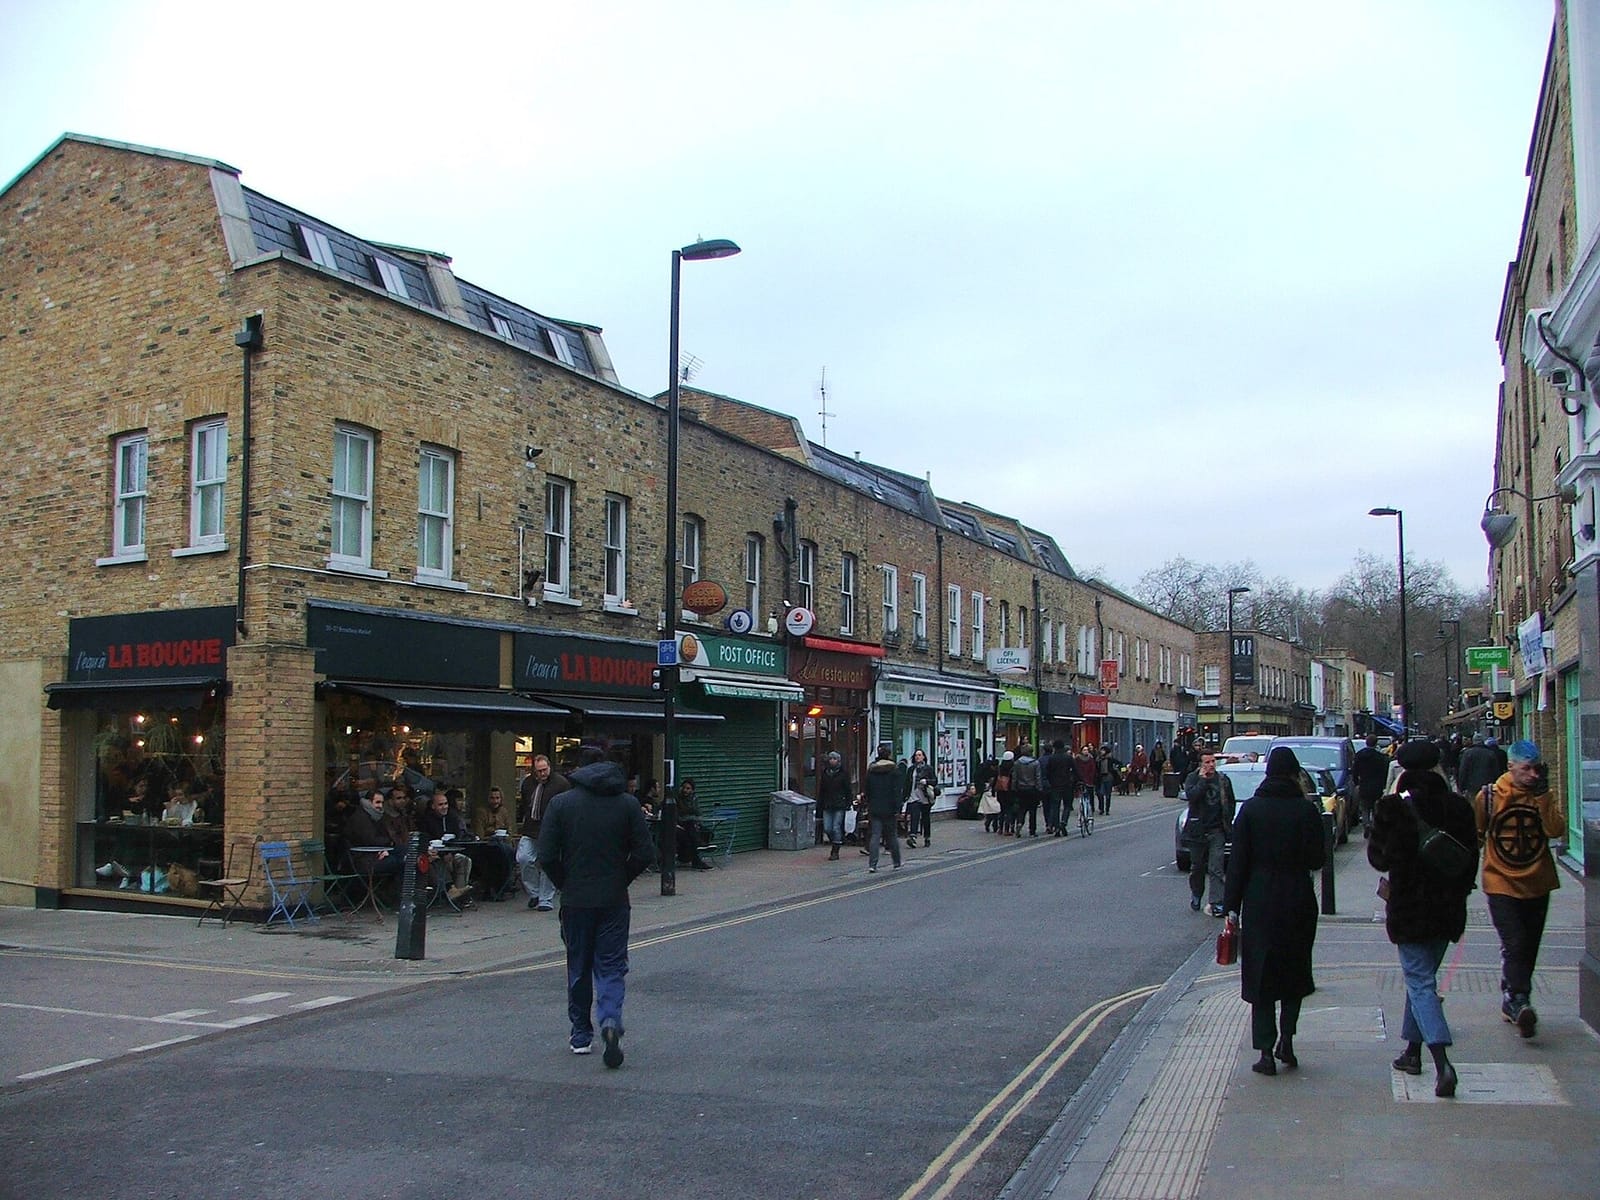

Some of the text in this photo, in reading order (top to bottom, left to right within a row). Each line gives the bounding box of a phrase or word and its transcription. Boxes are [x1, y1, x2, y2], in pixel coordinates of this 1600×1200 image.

[688, 597, 719, 607] OFFICE
[108, 644, 134, 669] LA
[138, 639, 222, 667] BOUCHE
[720, 645, 775, 667] POST OFFICE
[1474, 651, 1503, 659] Londis
[560, 653, 586, 681] LA
[821, 667, 864, 682] restaurant
